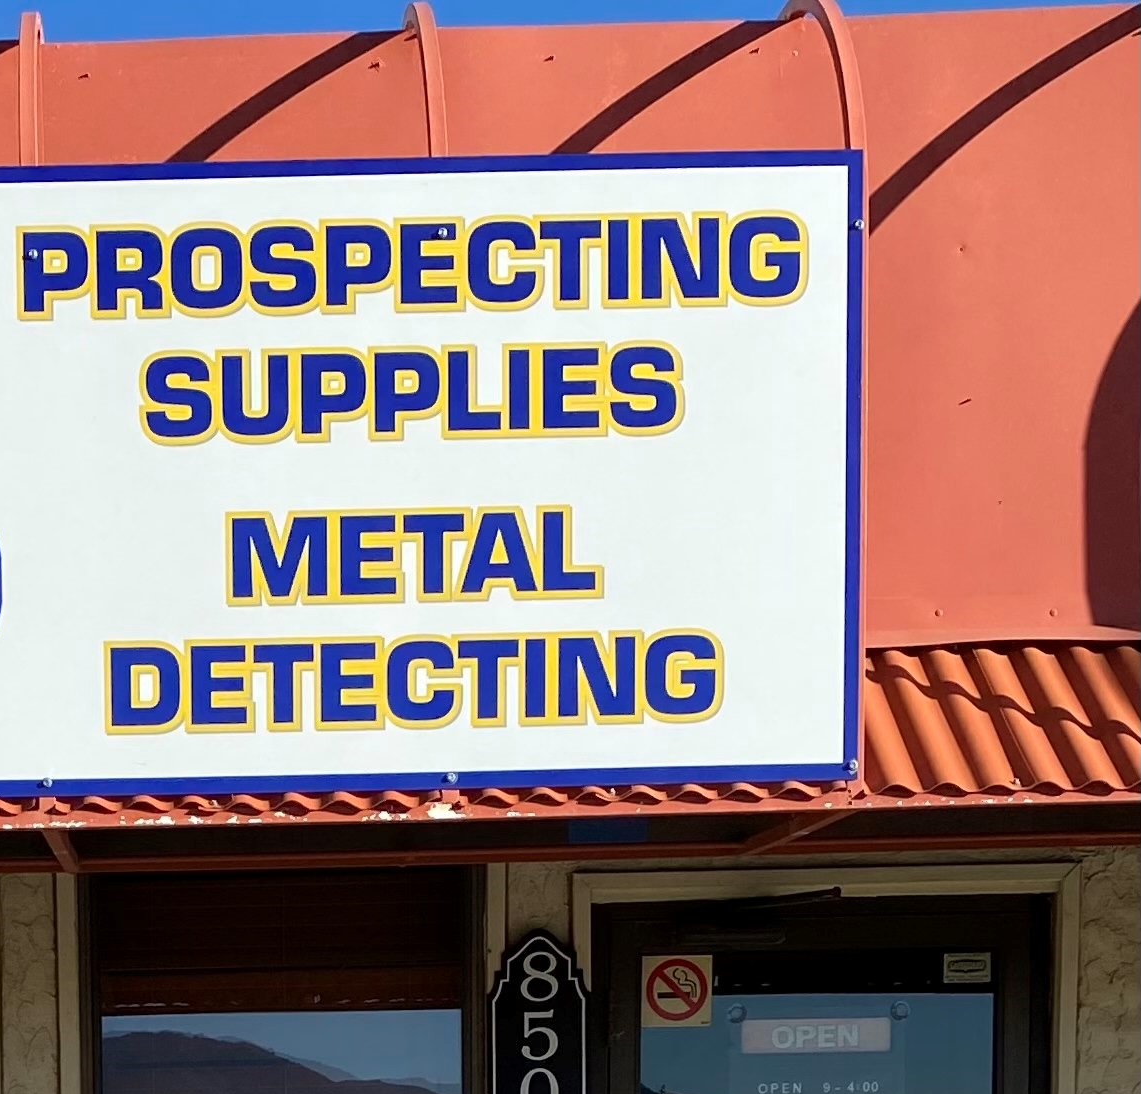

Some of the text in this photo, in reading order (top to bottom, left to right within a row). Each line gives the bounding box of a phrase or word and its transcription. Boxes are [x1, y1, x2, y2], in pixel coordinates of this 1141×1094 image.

[17, 210, 809, 321] PROSPECTING
[142, 342, 683, 444] SUPPLIES
[225, 505, 603, 606] METAL
[104, 629, 723, 734] DETECTING
[772, 1024, 858, 1048] OPEN
[758, 1082, 802, 1094] OPEN
